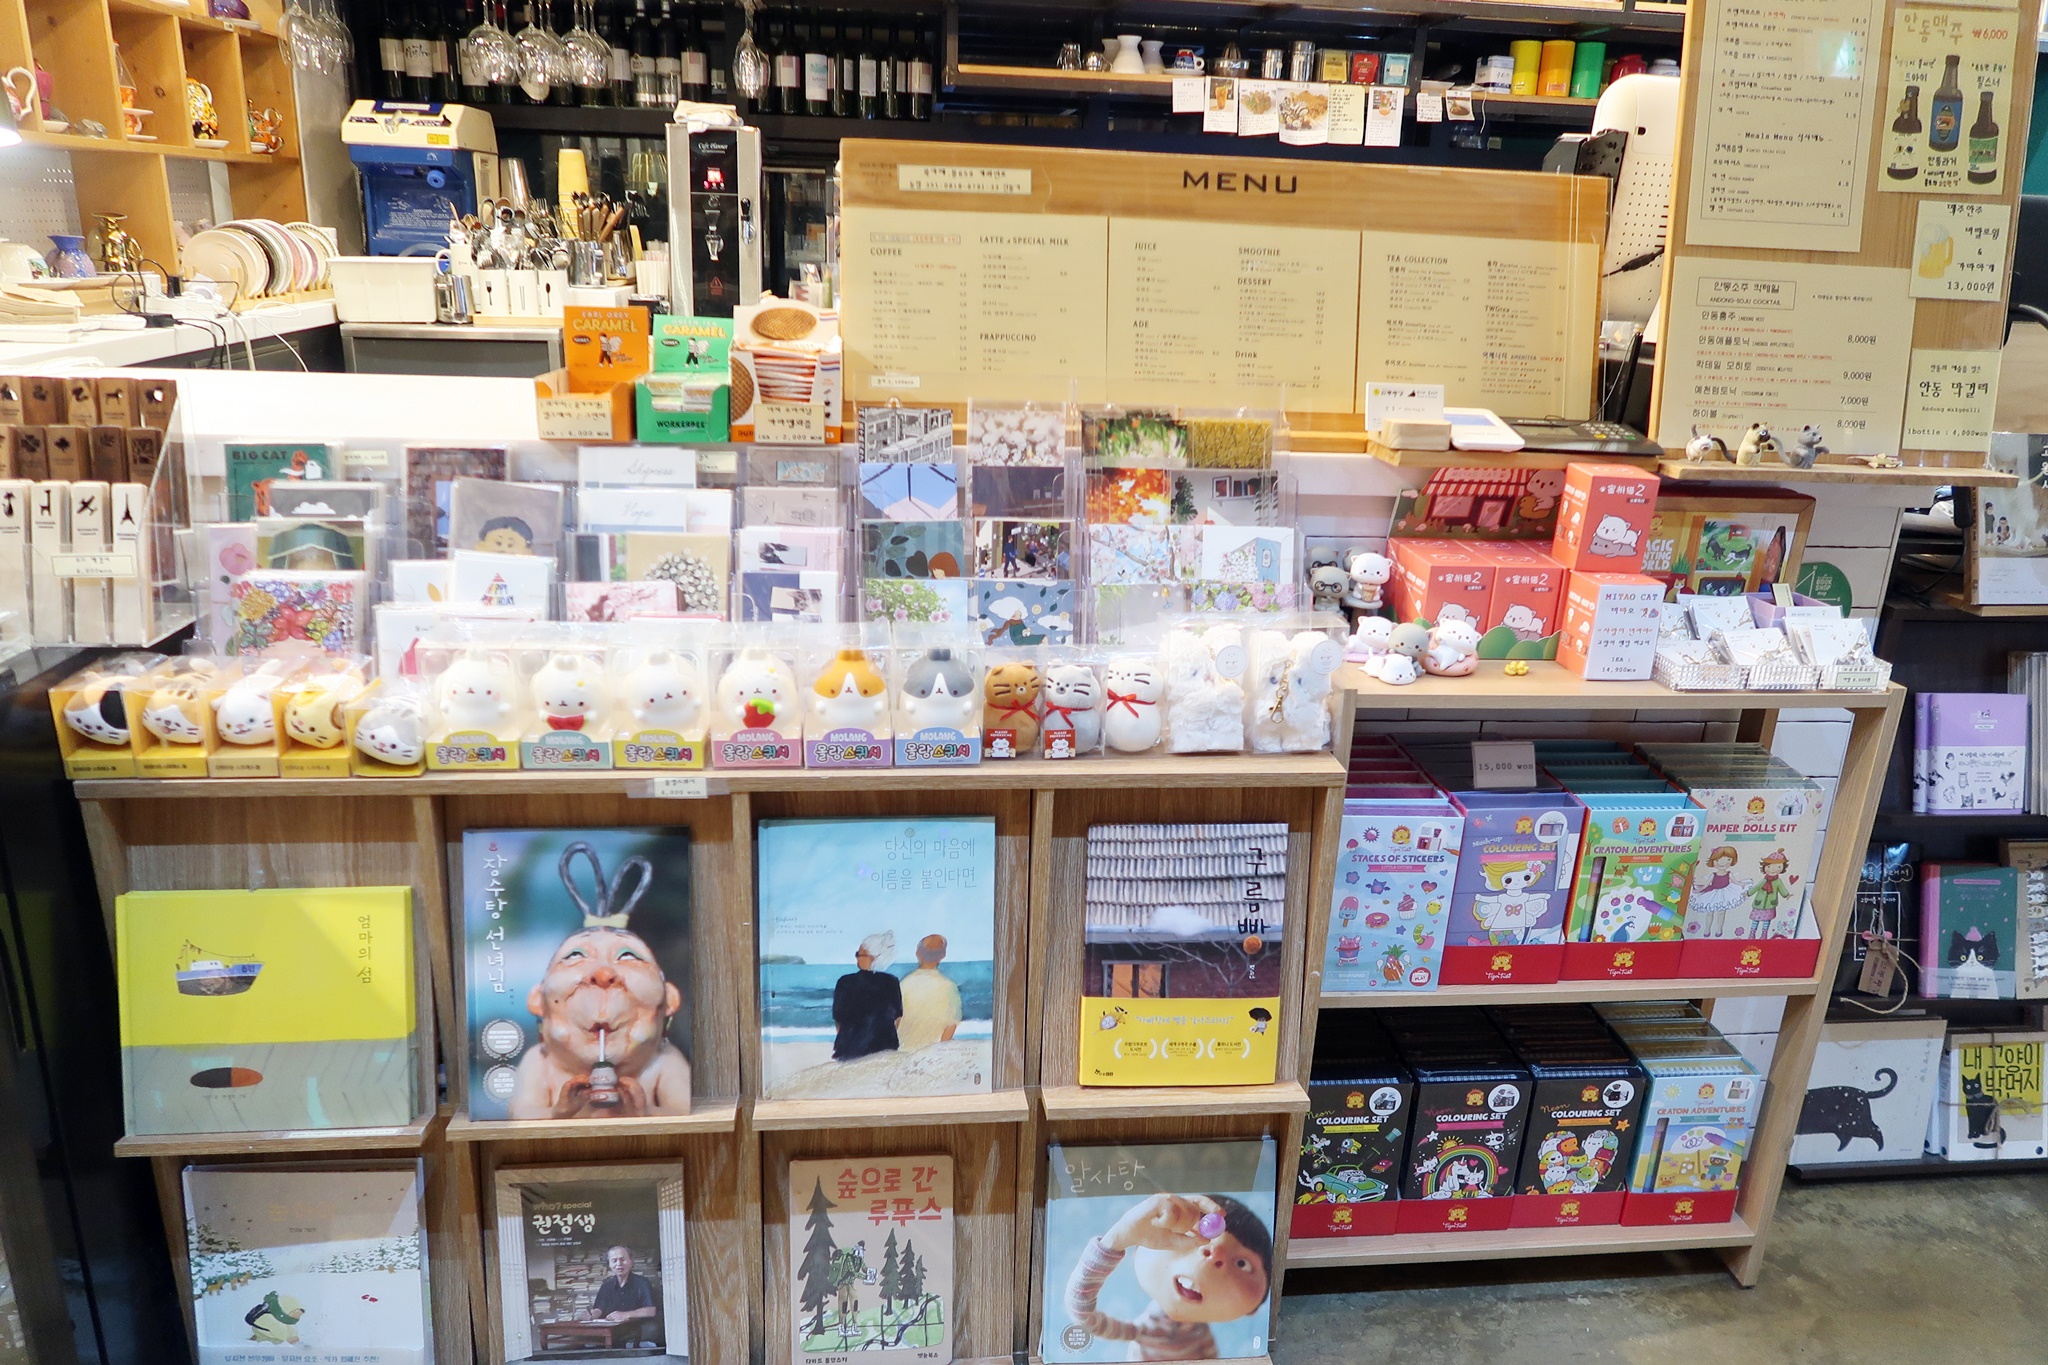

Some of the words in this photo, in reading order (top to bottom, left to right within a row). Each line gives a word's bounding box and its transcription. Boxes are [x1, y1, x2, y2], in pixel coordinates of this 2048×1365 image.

[1904, 12, 1963, 45] 안동맥주
[1971, 28, 2008, 40] ₩6,000
[1745, 132, 1770, 140] Meals
[1183, 170, 1298, 194] MENU
[1946, 204, 1982, 217] 맥주안주
[980, 236, 1004, 244] LATTE
[1013, 236, 1045, 246] SPECIAL
[1050, 238, 1069, 246] MILK
[1134, 242, 1157, 250] JUICE
[870, 247, 902, 256] COFFEE
[1238, 247, 1281, 257] SMOOTHIE
[1386, 254, 1400, 262] TEA
[1404, 256, 1448, 264] COLLECTION
[1238, 277, 1272, 286] DESSERT
[1713, 281, 1748, 293] 안동소주
[1947, 281, 1994, 294] 13,000원
[1710, 297, 1752, 305] ANDONG-SOJU
[1753, 298, 1782, 306] COCKTAIL
[582, 310, 602, 318] EARL
[1702, 310, 1736, 321] 안동홍주
[572, 318, 638, 333] CARAMEL
[1132, 320, 1149, 328] ADE
[662, 324, 728, 338] CARAMEL
[980, 332, 1036, 342] FRAPPUCCINO
[1698, 335, 1750, 346] 안동애플토닉
[1847, 334, 1876, 345] 8,000원
[1236, 350, 1258, 358] Drink
[1696, 360, 1722, 370] 칵테일
[1726, 361, 1752, 371] 모히토
[1842, 371, 1872, 382] 9,000원
[1694, 386, 1737, 396] 예천럼토닉
[1920, 381, 1942, 398] 안동
[1951, 382, 1988, 398] 막걸리
[1840, 396, 1869, 406] 7,000원
[1692, 409, 1718, 418] 하이볼
[656, 420, 706, 428] WORKERBEE
[1836, 420, 1866, 429] 8,000원
[232, 450, 259, 460] BIG
[261, 450, 287, 460] CAT
[737, 733, 775, 742] MOLANG
[830, 732, 868, 742] MOLANG
[920, 732, 956, 742] MOLANG
[1478, 762, 1512, 771] 15,000
[1706, 824, 1739, 833] PAPER
[1742, 824, 1776, 832] DOLLS
[1779, 824, 1798, 832] KIT
[884, 836, 926, 861] 당신의
[934, 838, 976, 860] 마음에
[1482, 844, 1536, 854] COLOURING
[1538, 843, 1557, 852] SET
[1631, 844, 1692, 854] ADVENTURES
[1351, 854, 1388, 863] STACKS
[1402, 854, 1445, 863] STICKERS
[871, 868, 913, 890] 이름을
[920, 868, 978, 890] 붙인다면
[483, 854, 508, 920] 장수탕
[1237, 847, 1271, 935] 구름빵
[358, 914, 374, 960] 엄마의
[486, 927, 506, 994] 선녀님
[356, 966, 372, 984] 섬
[1963, 1046, 1982, 1070] 내
[1988, 1044, 2040, 1073] 고양이
[1540, 1102, 1570, 1114] Neon
[1551, 1109, 1602, 1118] COLOURING
[1604, 1108, 1622, 1117] SET
[1692, 1106, 1747, 1114] ADVENTURES
[1306, 1108, 1336, 1120] Neon
[1436, 1113, 1488, 1122] COLOURING
[1490, 1112, 1508, 1120] SET
[1316, 1116, 1370, 1126] COLOURING
[1371, 1115, 1390, 1124] SET
[1065, 1160, 1146, 1193] 알사탕
[837, 1168, 902, 1199] 숲으로
[911, 1166, 938, 1192] 간
[534, 1202, 562, 1211] who?
[562, 1201, 592, 1210] special
[868, 1198, 942, 1227] 루푸스
[532, 1213, 596, 1235] 권정생
